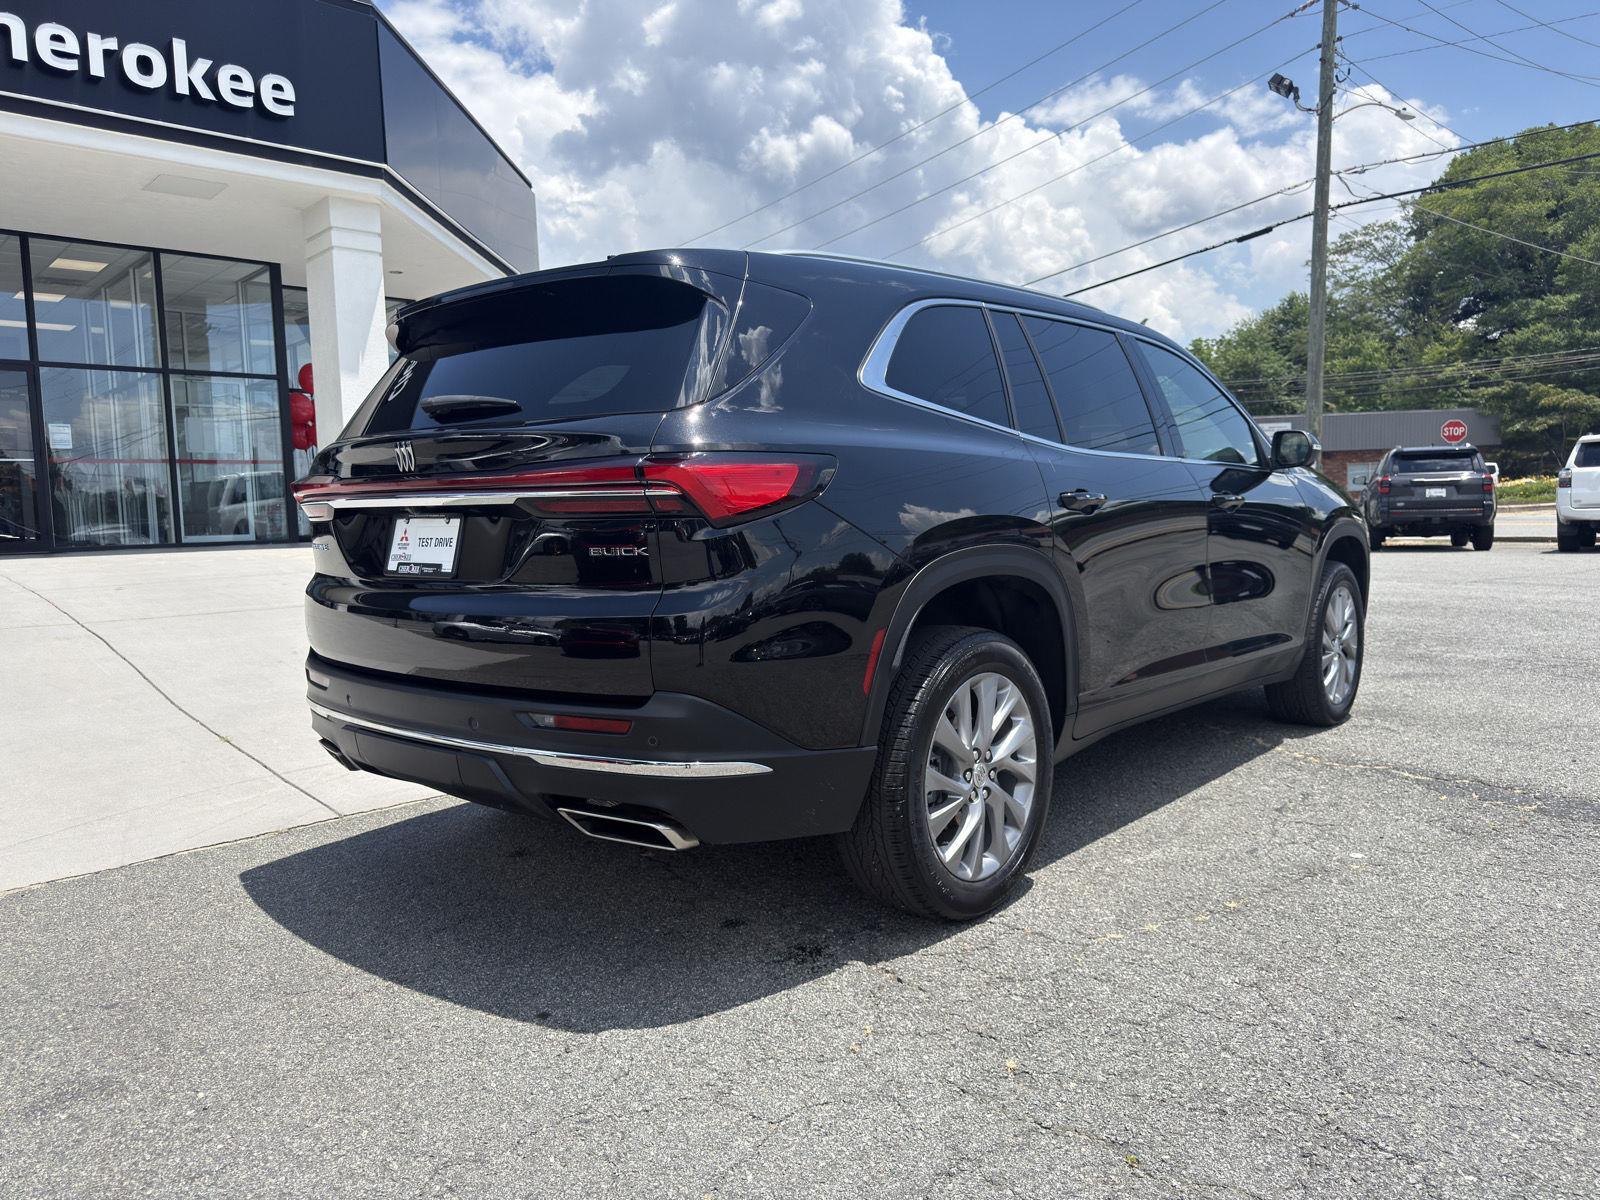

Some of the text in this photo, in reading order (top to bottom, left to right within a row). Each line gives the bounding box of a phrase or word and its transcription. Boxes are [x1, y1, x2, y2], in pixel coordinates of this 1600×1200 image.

[1443, 427, 1465, 436] STOP
[418, 537, 453, 548] TEST DRIVE
[589, 547, 649, 556] BUICK
